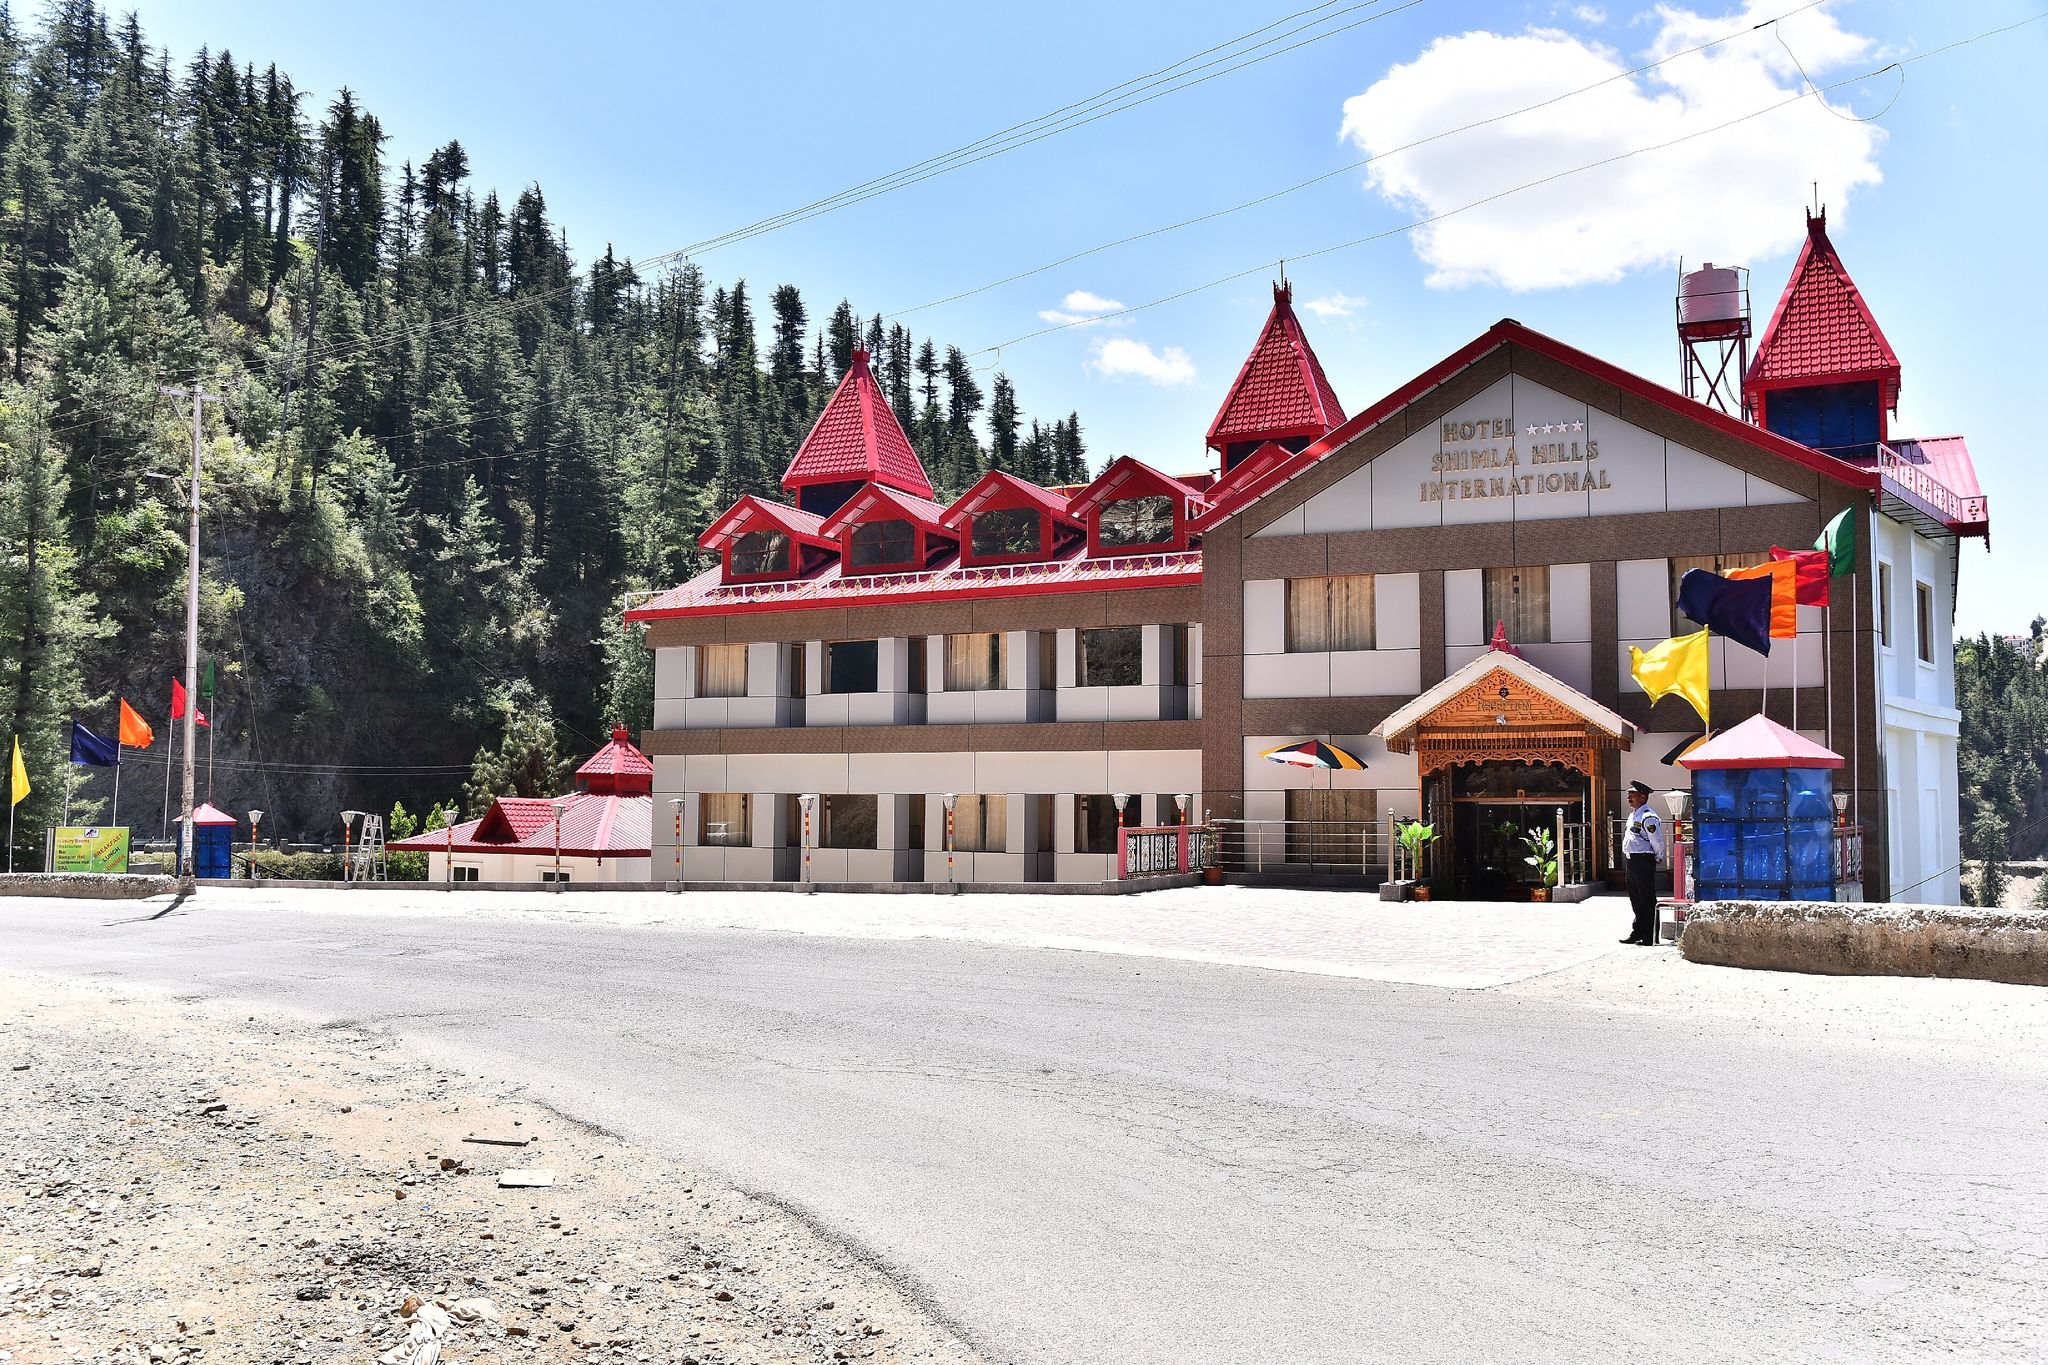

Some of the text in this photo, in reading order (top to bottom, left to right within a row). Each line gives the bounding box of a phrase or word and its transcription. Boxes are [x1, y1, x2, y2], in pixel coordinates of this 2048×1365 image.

[1443, 418, 1515, 442] HOTEL
[1432, 440, 1599, 473] SHIMLA HILLS
[1420, 469, 1612, 503] INTERNATIONAL
[93, 833, 123, 859] BREAKFAST
[102, 846, 121, 863] LUNCH
[106, 854, 126, 871] DINNER
